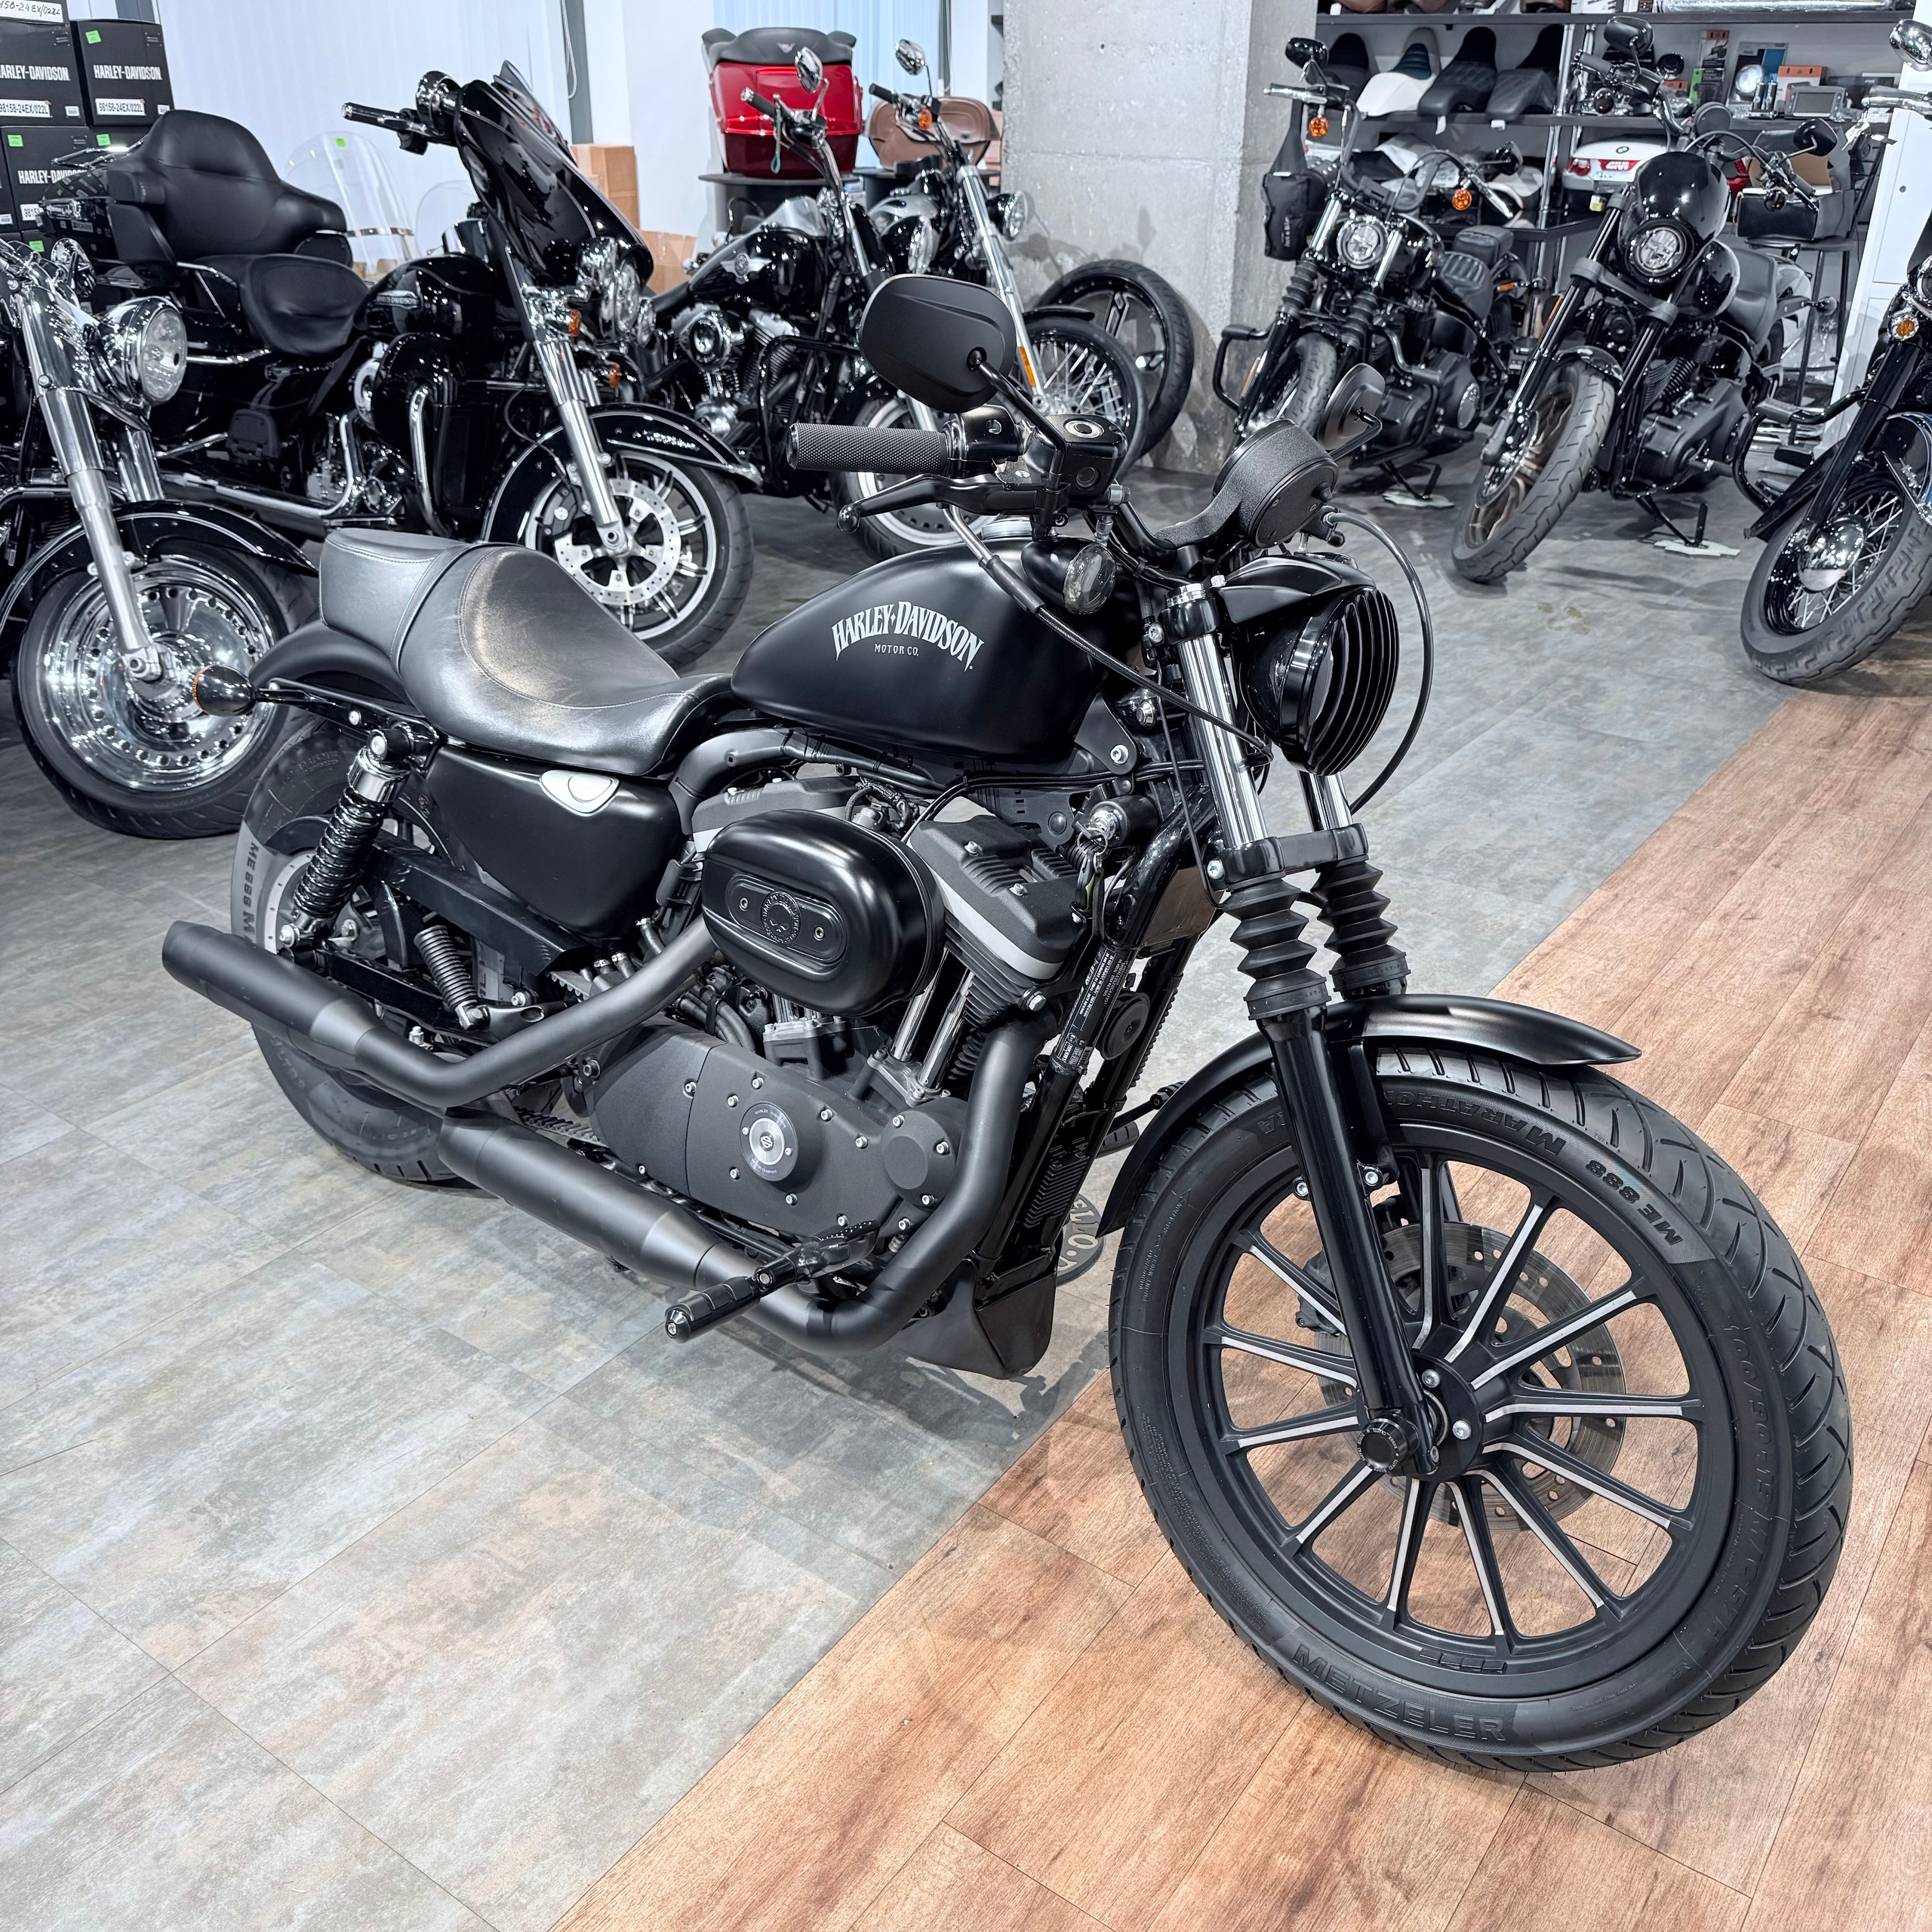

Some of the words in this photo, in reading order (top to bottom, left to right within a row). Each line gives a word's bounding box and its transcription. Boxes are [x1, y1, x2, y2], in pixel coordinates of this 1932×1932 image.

[0, 64, 70, 81] ARLEY-DAVIDSON
[94, 65, 162, 81] HARLEY-DAVIDSON
[99, 103, 143, 112] 98158-24EX/022L
[875, 644, 904, 654] MOTOR
[907, 646, 919, 656] CO.
[247, 841, 259, 871] ME
[243, 872, 254, 908] 888
[1586, 1160, 1641, 1204] 888
[1637, 1203, 1684, 1246] ME
[1293, 1644, 1506, 1742] METZELER
